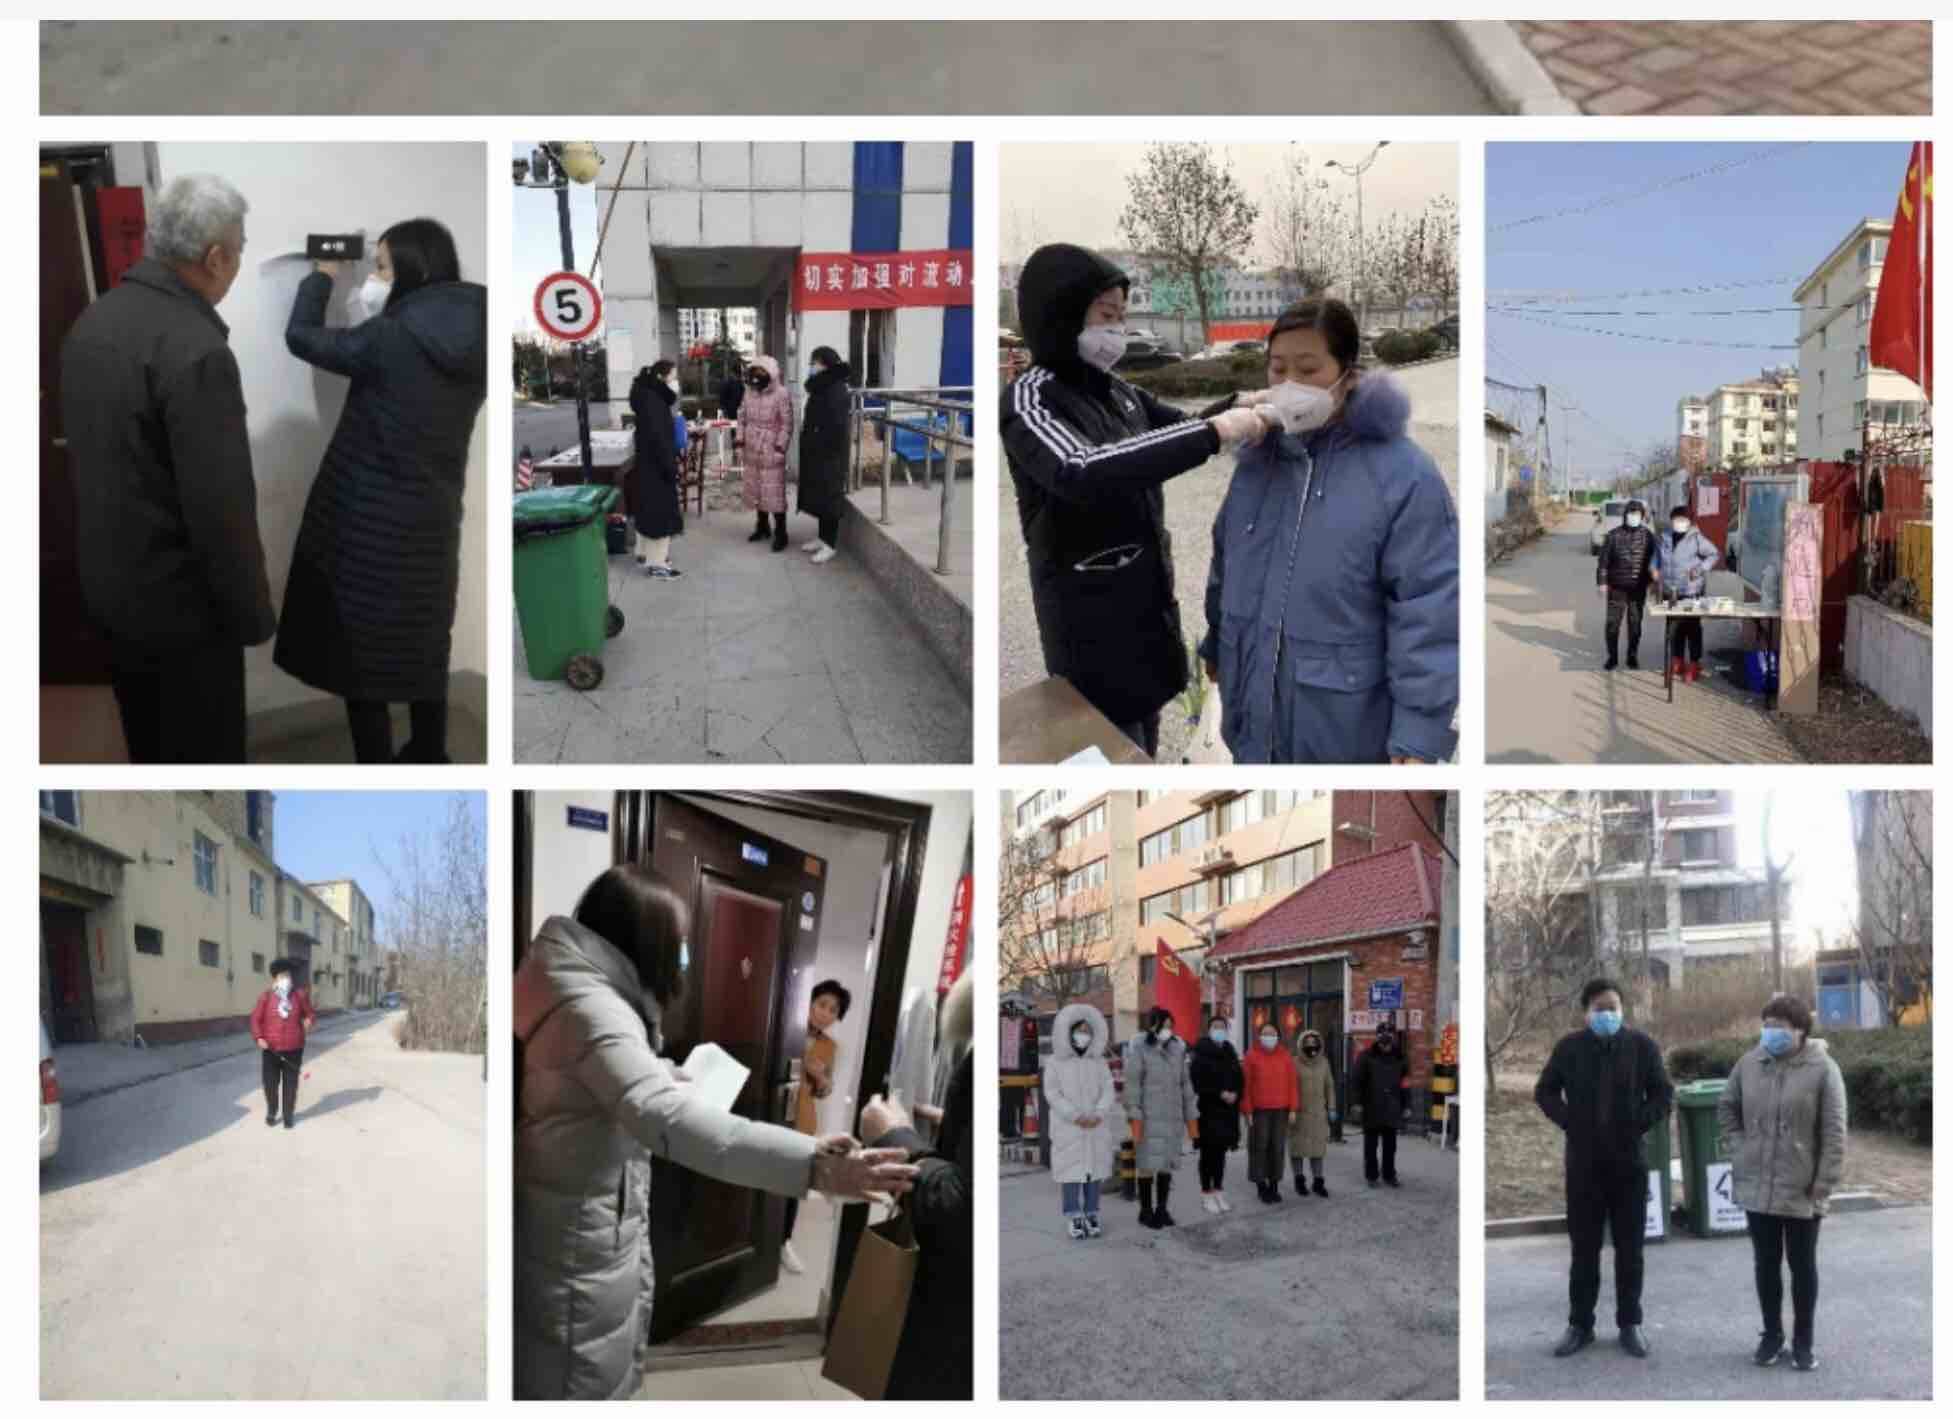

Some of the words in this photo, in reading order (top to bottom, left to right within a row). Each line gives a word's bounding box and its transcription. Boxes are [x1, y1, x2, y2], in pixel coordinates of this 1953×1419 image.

[804, 260, 973, 292] 切实加强对流动
[556, 288, 581, 323] 5
